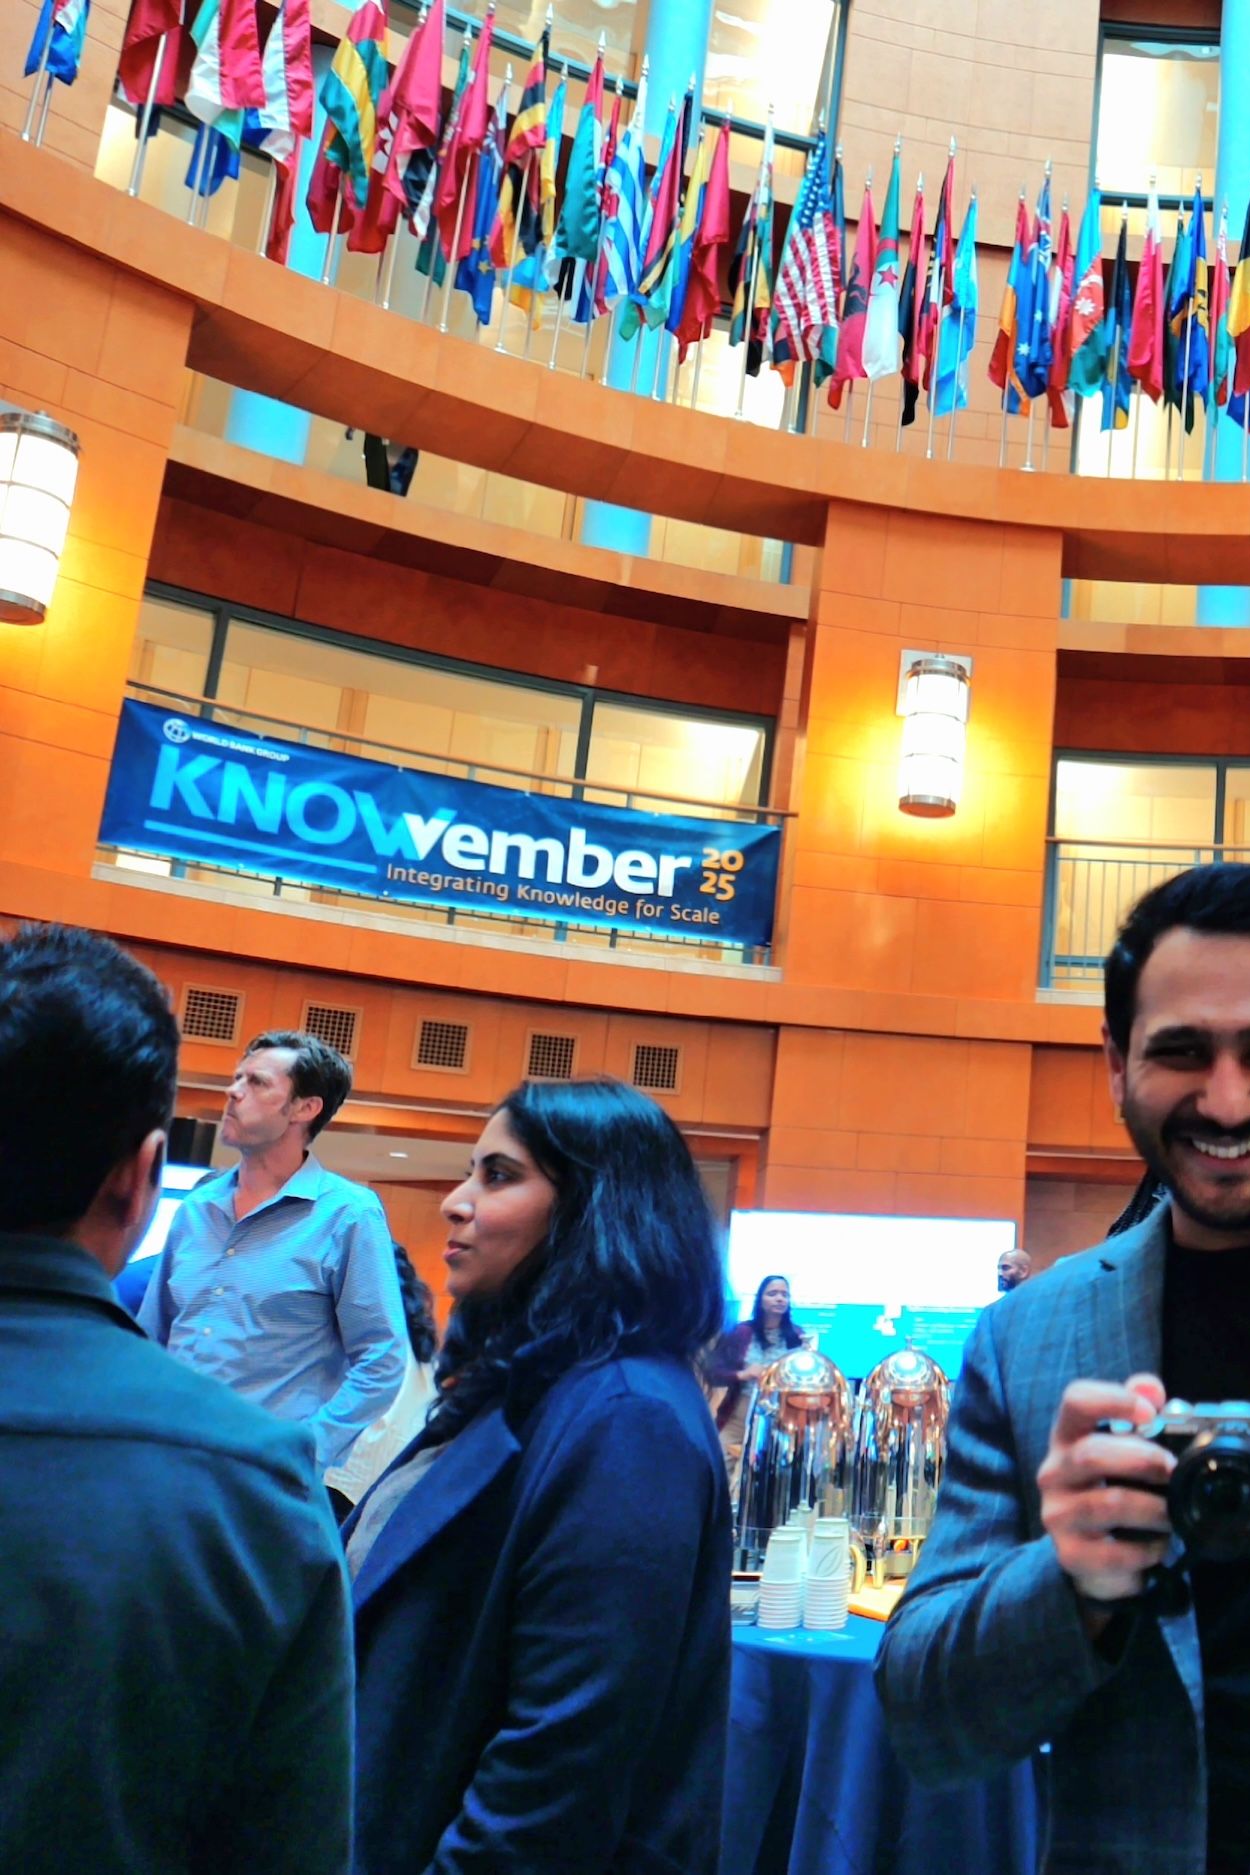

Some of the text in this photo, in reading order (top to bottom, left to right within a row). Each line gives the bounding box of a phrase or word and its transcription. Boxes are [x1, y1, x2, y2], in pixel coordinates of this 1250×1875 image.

[192, 731, 290, 762] WORLD BANK GROUP
[702, 847, 745, 872] 20
[387, 863, 721, 925] Integrating Knowledge for Scale
[699, 871, 736, 901] 25
